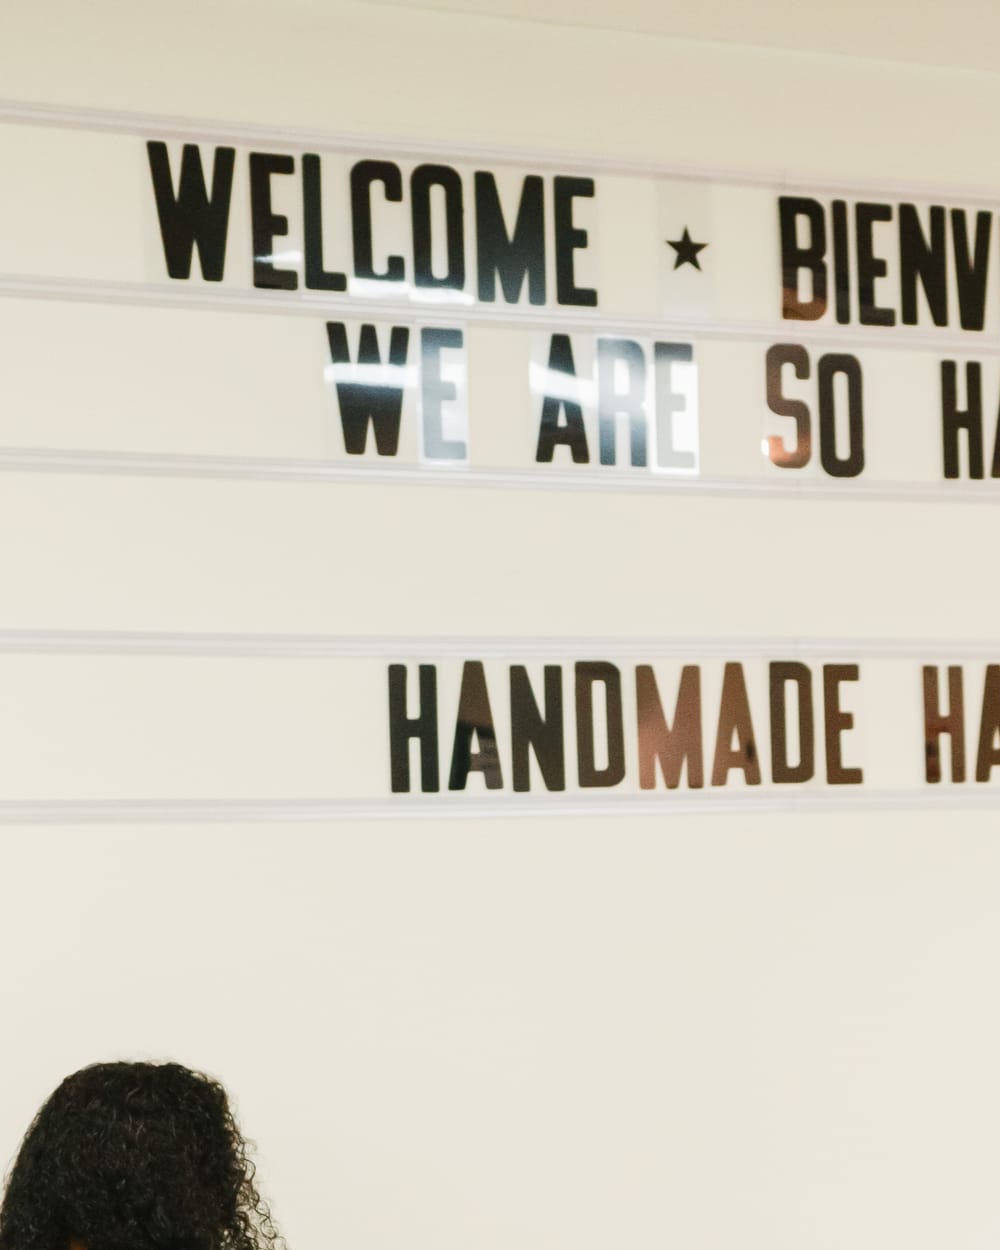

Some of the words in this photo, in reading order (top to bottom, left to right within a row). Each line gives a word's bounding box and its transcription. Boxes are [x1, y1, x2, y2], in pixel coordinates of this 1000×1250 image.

[146, 140, 599, 307] WELCOME
[325, 321, 468, 457] WE
[536, 333, 696, 468] ARE
[765, 343, 865, 478] SO
[388, 660, 864, 793] HANDMADE
